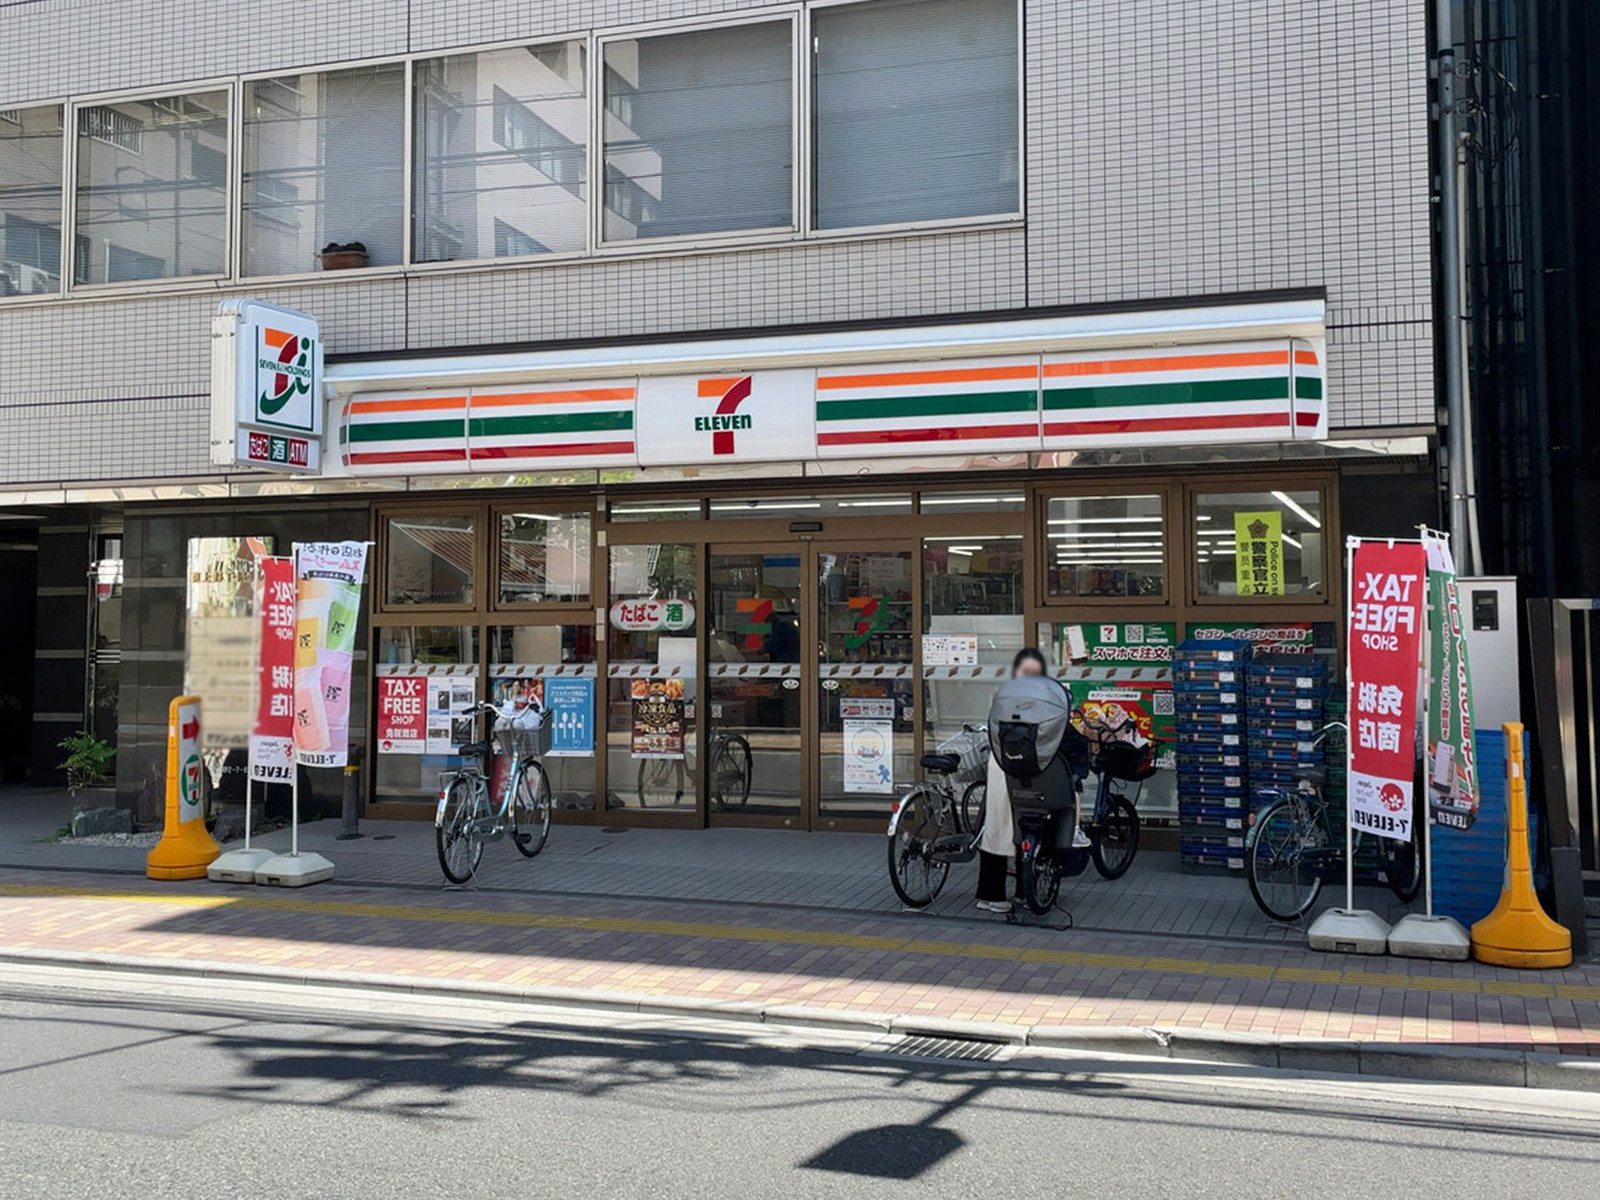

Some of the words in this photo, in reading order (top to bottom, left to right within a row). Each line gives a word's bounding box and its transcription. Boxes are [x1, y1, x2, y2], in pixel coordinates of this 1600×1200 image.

[289, 442, 307, 463] ATM
[1270, 541, 1279, 571] Police
[620, 603, 659, 622] たばこ
[666, 603, 684, 622] 酒
[385, 679, 421, 696] TAX-
[383, 697, 421, 714] FREE
[390, 715, 415, 725] SHOP
